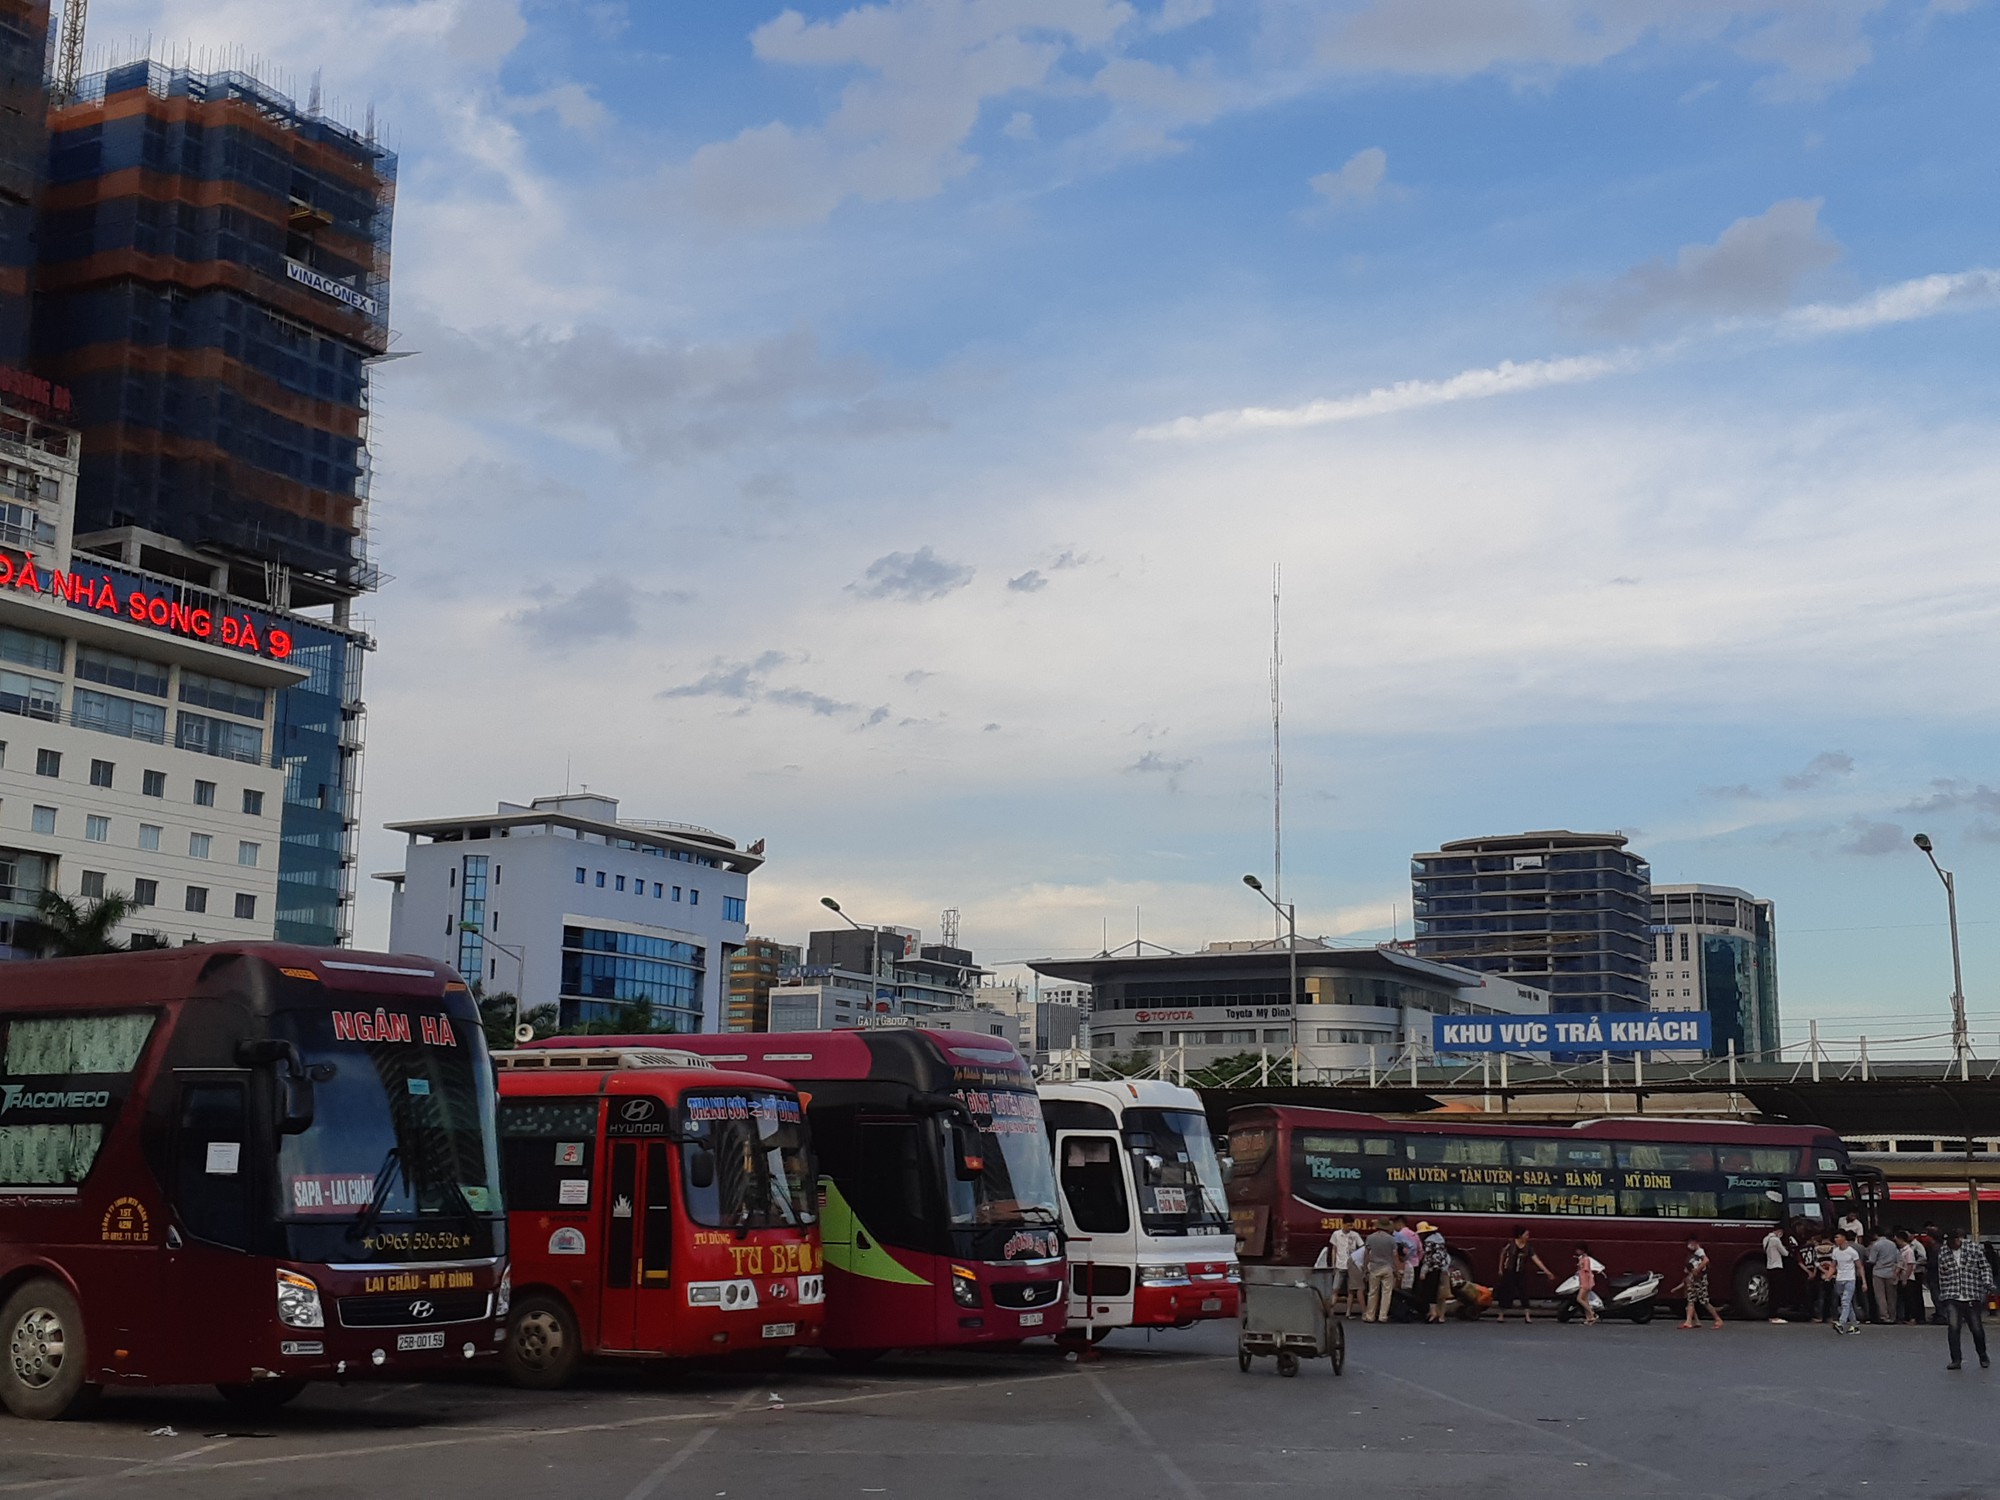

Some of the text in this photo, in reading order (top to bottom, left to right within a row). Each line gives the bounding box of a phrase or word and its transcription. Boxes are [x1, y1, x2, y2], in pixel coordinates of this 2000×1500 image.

[289, 265, 376, 314] VINACONEX 1
[53, 569, 119, 614] NHÀ
[221, 614, 260, 651] ĐÀ
[269, 630, 292, 658] 9
[332, 1007, 457, 1047] NGÂN HÀ
[1151, 1010, 1195, 1021] TOYOTA
[1225, 1008, 1253, 1020] Toyota
[1443, 1016, 1698, 1048] KHU VỰC TRẢ KHÁCH
[0, 1084, 110, 1116] TRACOMECO
[609, 1123, 664, 1133] HYUNDAI
[1312, 1163, 1361, 1181] Home
[1418, 1165, 1448, 1183] UYÊN
[1459, 1166, 1482, 1182] TÂN
[1484, 1167, 1513, 1184] UYÊN
[1523, 1171, 1551, 1185] SAPA
[1565, 1169, 1581, 1186] HÀ
[1583, 1171, 1603, 1189] NỘI
[1625, 1171, 1641, 1188] MỸ
[1644, 1171, 1672, 1189] ĐÌNH
[294, 1181, 323, 1207] SAPA
[330, 1180, 348, 1206] LAI
[348, 1174, 375, 1205] CHÂU
[365, 1276, 384, 1292] LAI
[387, 1272, 419, 1291] CHÂU
[429, 1270, 445, 1289] MỸ
[448, 1270, 474, 1288] ĐÌNH
